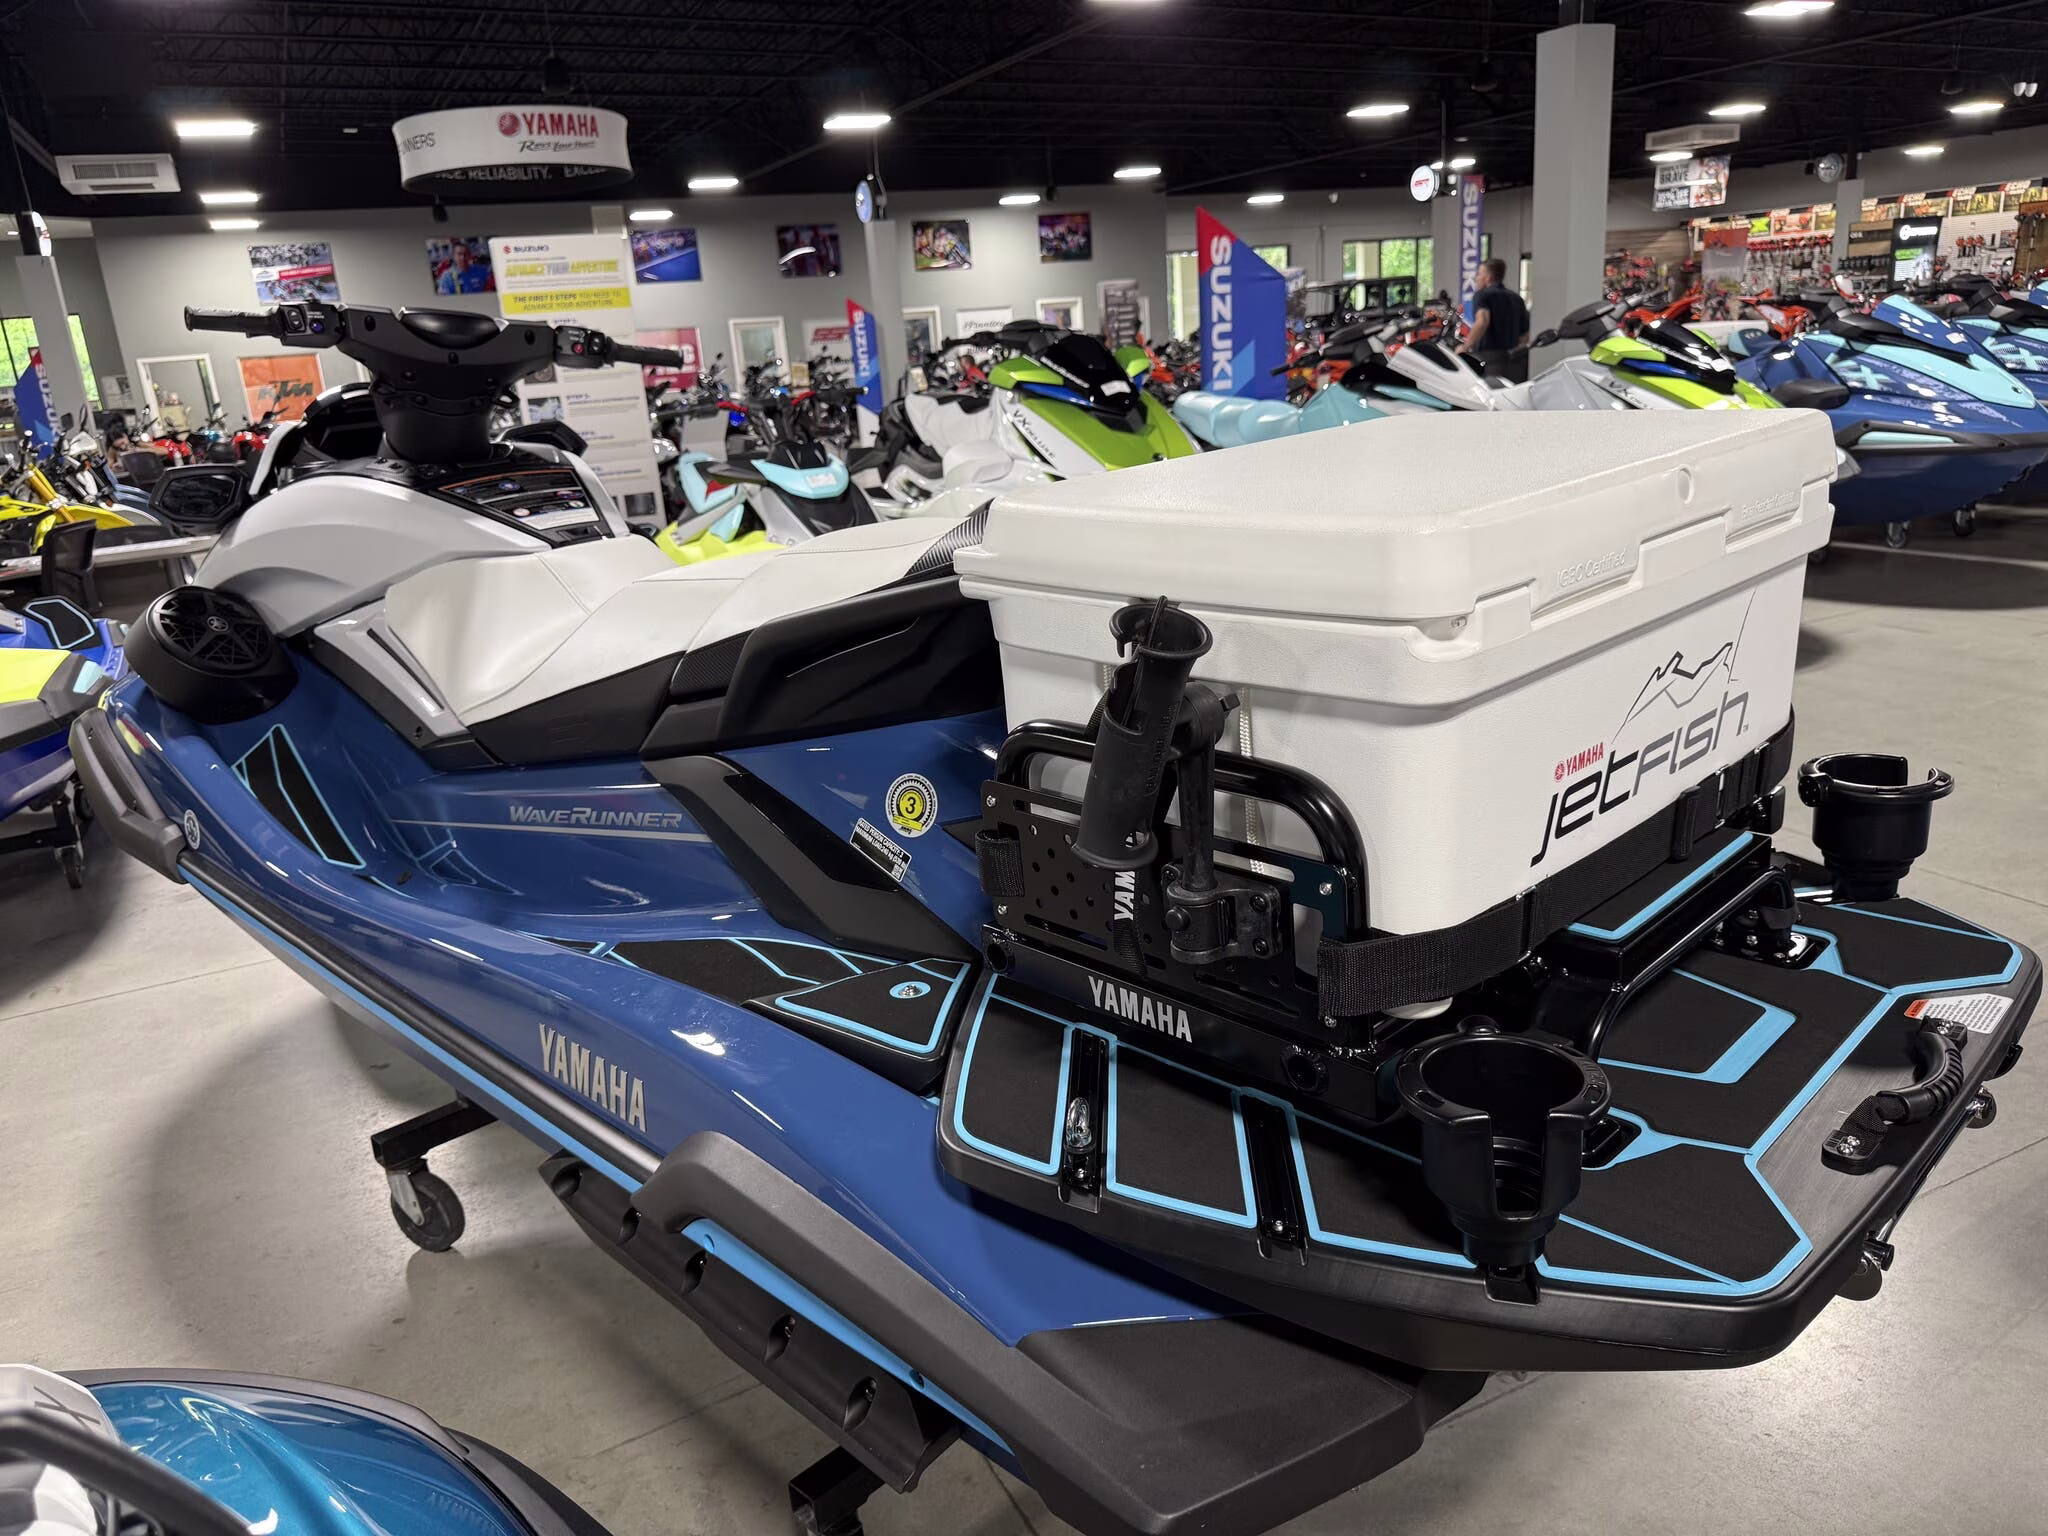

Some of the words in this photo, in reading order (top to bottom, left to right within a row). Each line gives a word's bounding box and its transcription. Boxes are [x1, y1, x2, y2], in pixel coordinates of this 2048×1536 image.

[523, 113, 599, 138] YAMAHA
[1209, 235, 1233, 391] SUZUKI
[852, 309, 870, 377] SUZUKI
[257, 379, 313, 401] KTM
[1566, 742, 1604, 777] YAMAHA
[906, 797, 916, 815] 3
[1088, 975, 1193, 1043] YAMAHA
[539, 1022, 648, 1133] YAMAHA
